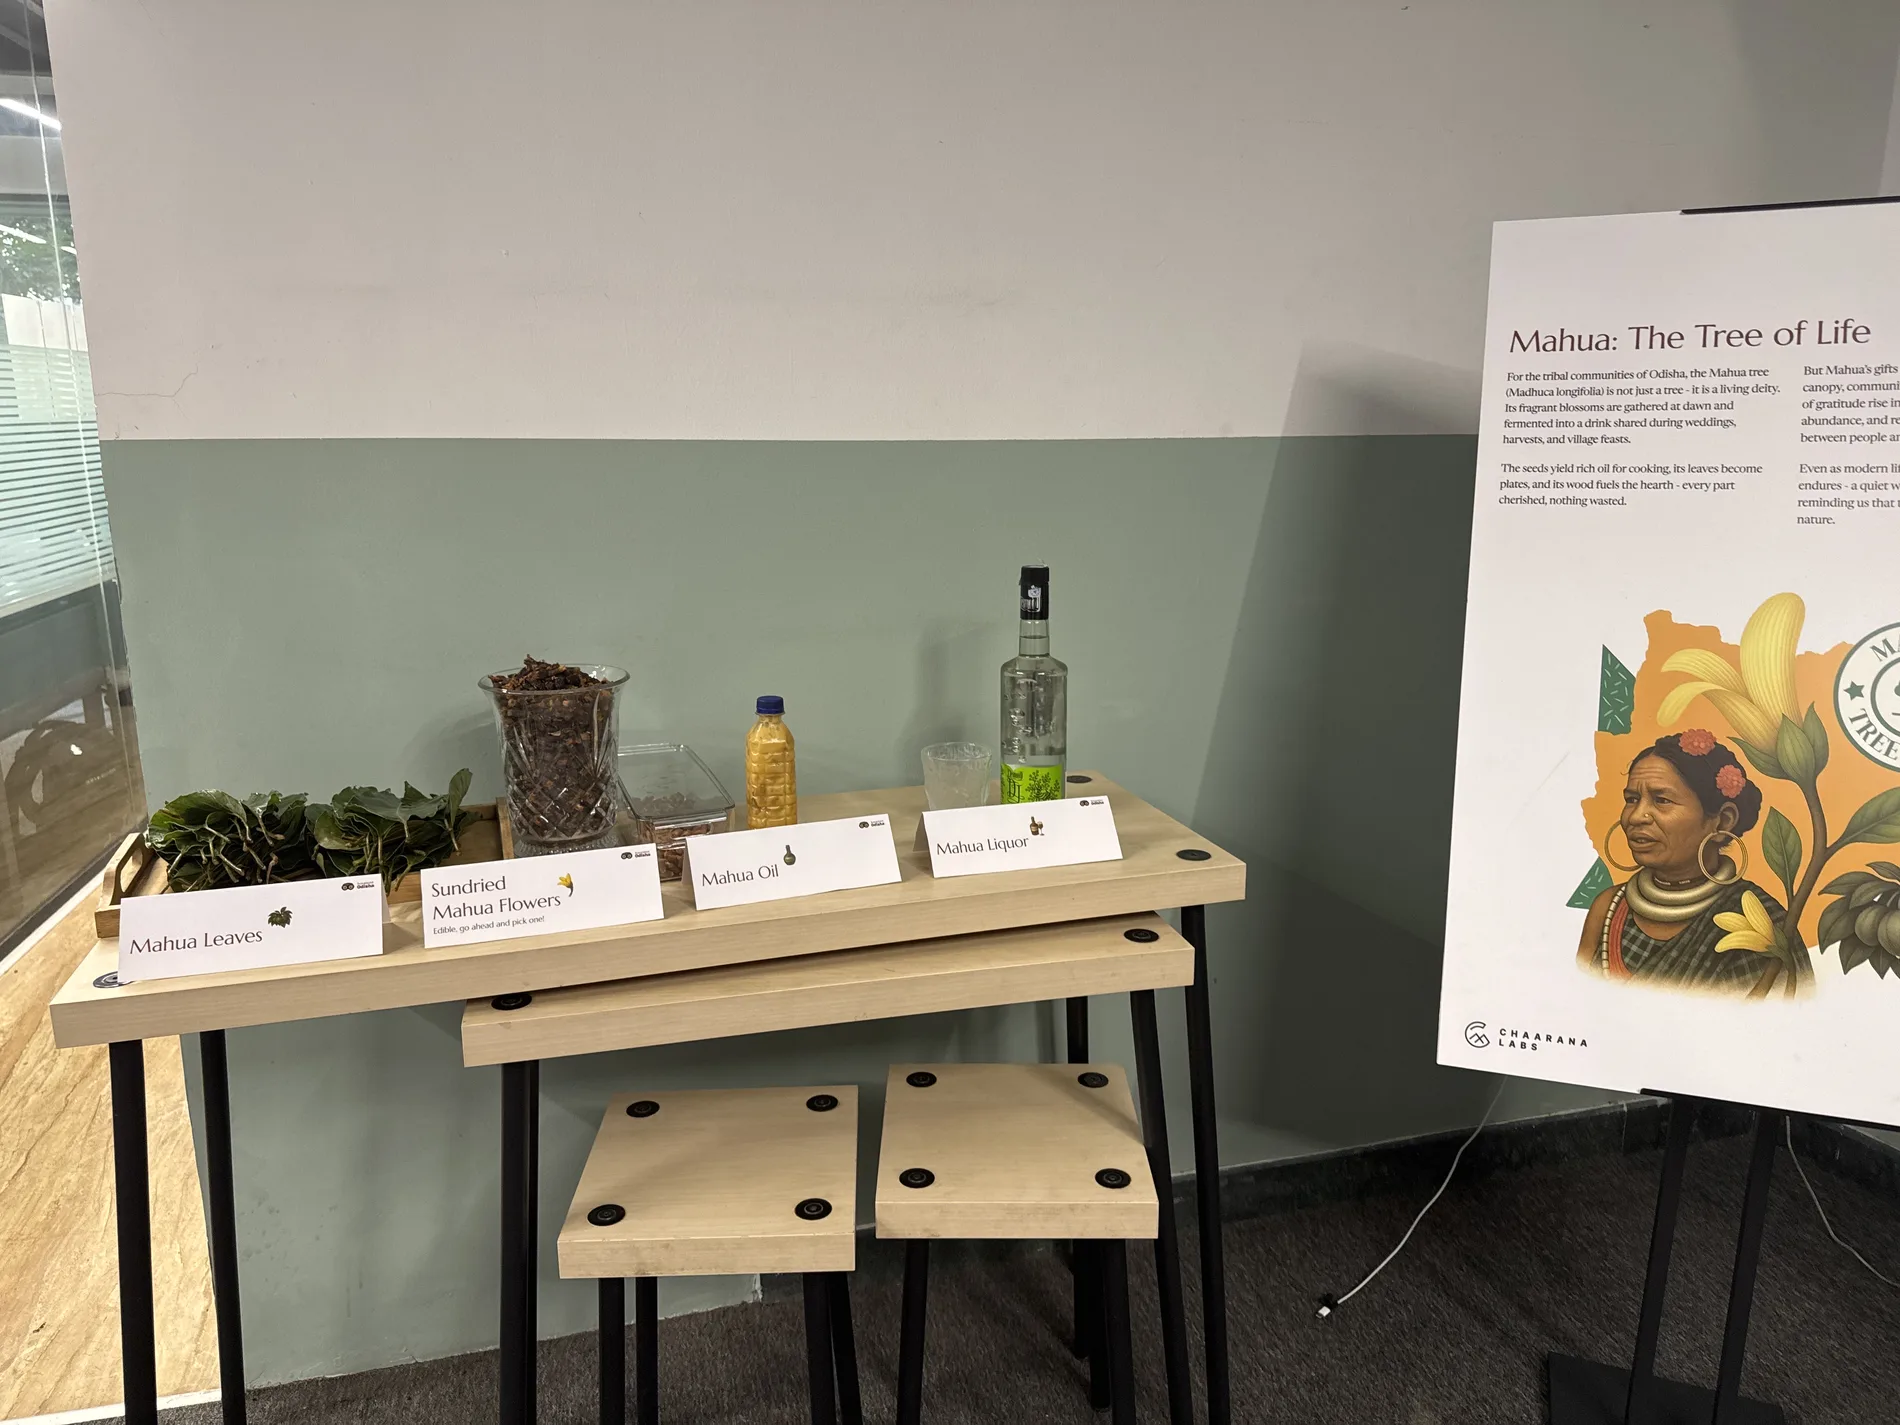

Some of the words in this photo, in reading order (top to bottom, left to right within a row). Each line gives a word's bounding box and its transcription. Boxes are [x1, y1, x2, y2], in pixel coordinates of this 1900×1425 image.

[1509, 328, 1617, 353] Mahua:
[1628, 325, 1684, 350] The
[1695, 323, 1763, 349] Tree
[1773, 319, 1808, 346] of
[1817, 318, 1872, 346] Life
[1507, 372, 1524, 381] For
[1525, 371, 1541, 381] the
[1543, 371, 1568, 381] tribal
[1570, 370, 1634, 380] communities
[1636, 370, 1647, 379] of
[1649, 369, 1688, 380] Odisha,
[1690, 368, 1707, 378] the
[1709, 368, 1747, 377] Mahua
[1749, 368, 1770, 377] tree
[1804, 365, 1824, 375] But
[1873, 364, 1899, 376] gifts
[1505, 387, 1554, 397] (Madhuca
[1556, 386, 1604, 398] longifolia)
[1606, 386, 1614, 395] is
[1616, 386, 1633, 395] not
[1635, 386, 1653, 397] just
[1663, 386, 1684, 394] tree
[1692, 385, 1700, 394] it
[1701, 384, 1710, 394] is
[1712, 386, 1718, 394] a
[1720, 384, 1750, 396] living
[1751, 384, 1781, 396] deity.
[1802, 384, 1845, 394] canopy,
[1505, 403, 1517, 413] Its
[1519, 403, 1557, 414] fragrant
[1559, 403, 1604, 412] blossoms
[1606, 403, 1622, 412] are
[1623, 402, 1668, 413] gathered
[1670, 402, 1681, 411] at
[1682, 401, 1711, 411] dawn
[1713, 400, 1734, 410] and
[1802, 399, 1815, 409] of
[1815, 398, 1866, 411] gratitude
[1868, 398, 1888, 408] rise
[1504, 419, 1553, 428] fermented
[1555, 419, 1575, 428] into
[1576, 420, 1582, 428] a
[1585, 419, 1611, 428] drink
[1613, 418, 1647, 428] shared
[1649, 418, 1683, 429] during
[1685, 417, 1736, 428] weddings,
[1801, 416, 1865, 426] abundance,
[1866, 415, 1888, 425] and
[1503, 435, 1545, 445] harvests,
[1546, 434, 1566, 444] and
[1567, 434, 1599, 446] village
[1600, 434, 1631, 444] feasts.
[1800, 433, 1847, 442] between
[1849, 432, 1887, 444] people
[1501, 463, 1521, 473] The
[1522, 463, 1549, 473] seeds
[1550, 463, 1574, 475] yield
[1576, 463, 1595, 474] rich
[1597, 463, 1610, 474] oil
[1612, 463, 1627, 474] for
[1628, 464, 1672, 476] cooking,
[1673, 464, 1686, 474] its
[1687, 464, 1719, 474] leaves
[1720, 464, 1763, 474] become
[1800, 464, 1827, 473] Even
[1830, 465, 1841, 473] as
[1844, 464, 1888, 473] modern
[1499, 479, 1530, 491] plates,
[1532, 480, 1550, 489] and
[1552, 480, 1564, 489] its
[1566, 480, 1594, 490] wood
[1595, 480, 1620, 490] fuels
[1622, 480, 1638, 490] the
[1640, 480, 1673, 490] hearth
[1682, 482, 1711, 492] every
[1713, 481, 1735, 492] part
[1798, 481, 1842, 491] endures
[1851, 482, 1857, 490] a
[1860, 481, 1889, 493] quiet
[1498, 496, 1548, 506] cherished,
[1549, 496, 1588, 507] nothing
[1590, 496, 1627, 506] wasted.
[1798, 497, 1855, 510] reminding
[1857, 499, 1869, 508] us
[1872, 498, 1895, 508] that
[1797, 516, 1835, 525] nature.
[937, 839, 984, 855] Mahua
[987, 836, 1029, 853] Liquor
[702, 870, 754, 887] Mahua
[758, 864, 779, 879] Oil
[431, 876, 506, 898] Sundried
[432, 902, 494, 920] Mahua
[499, 894, 561, 913] Flowers
[433, 926, 458, 934] Edible,
[460, 926, 470, 934] go
[471, 921, 494, 930] ahead
[496, 919, 510, 928] and
[512, 917, 527, 927] pick
[528, 916, 545, 924] one!
[129, 936, 197, 955] Mahua
[204, 930, 263, 948] Leaves
[1499, 1028, 1588, 1047] CHAARANA
[1499, 1039, 1538, 1051] LABS
